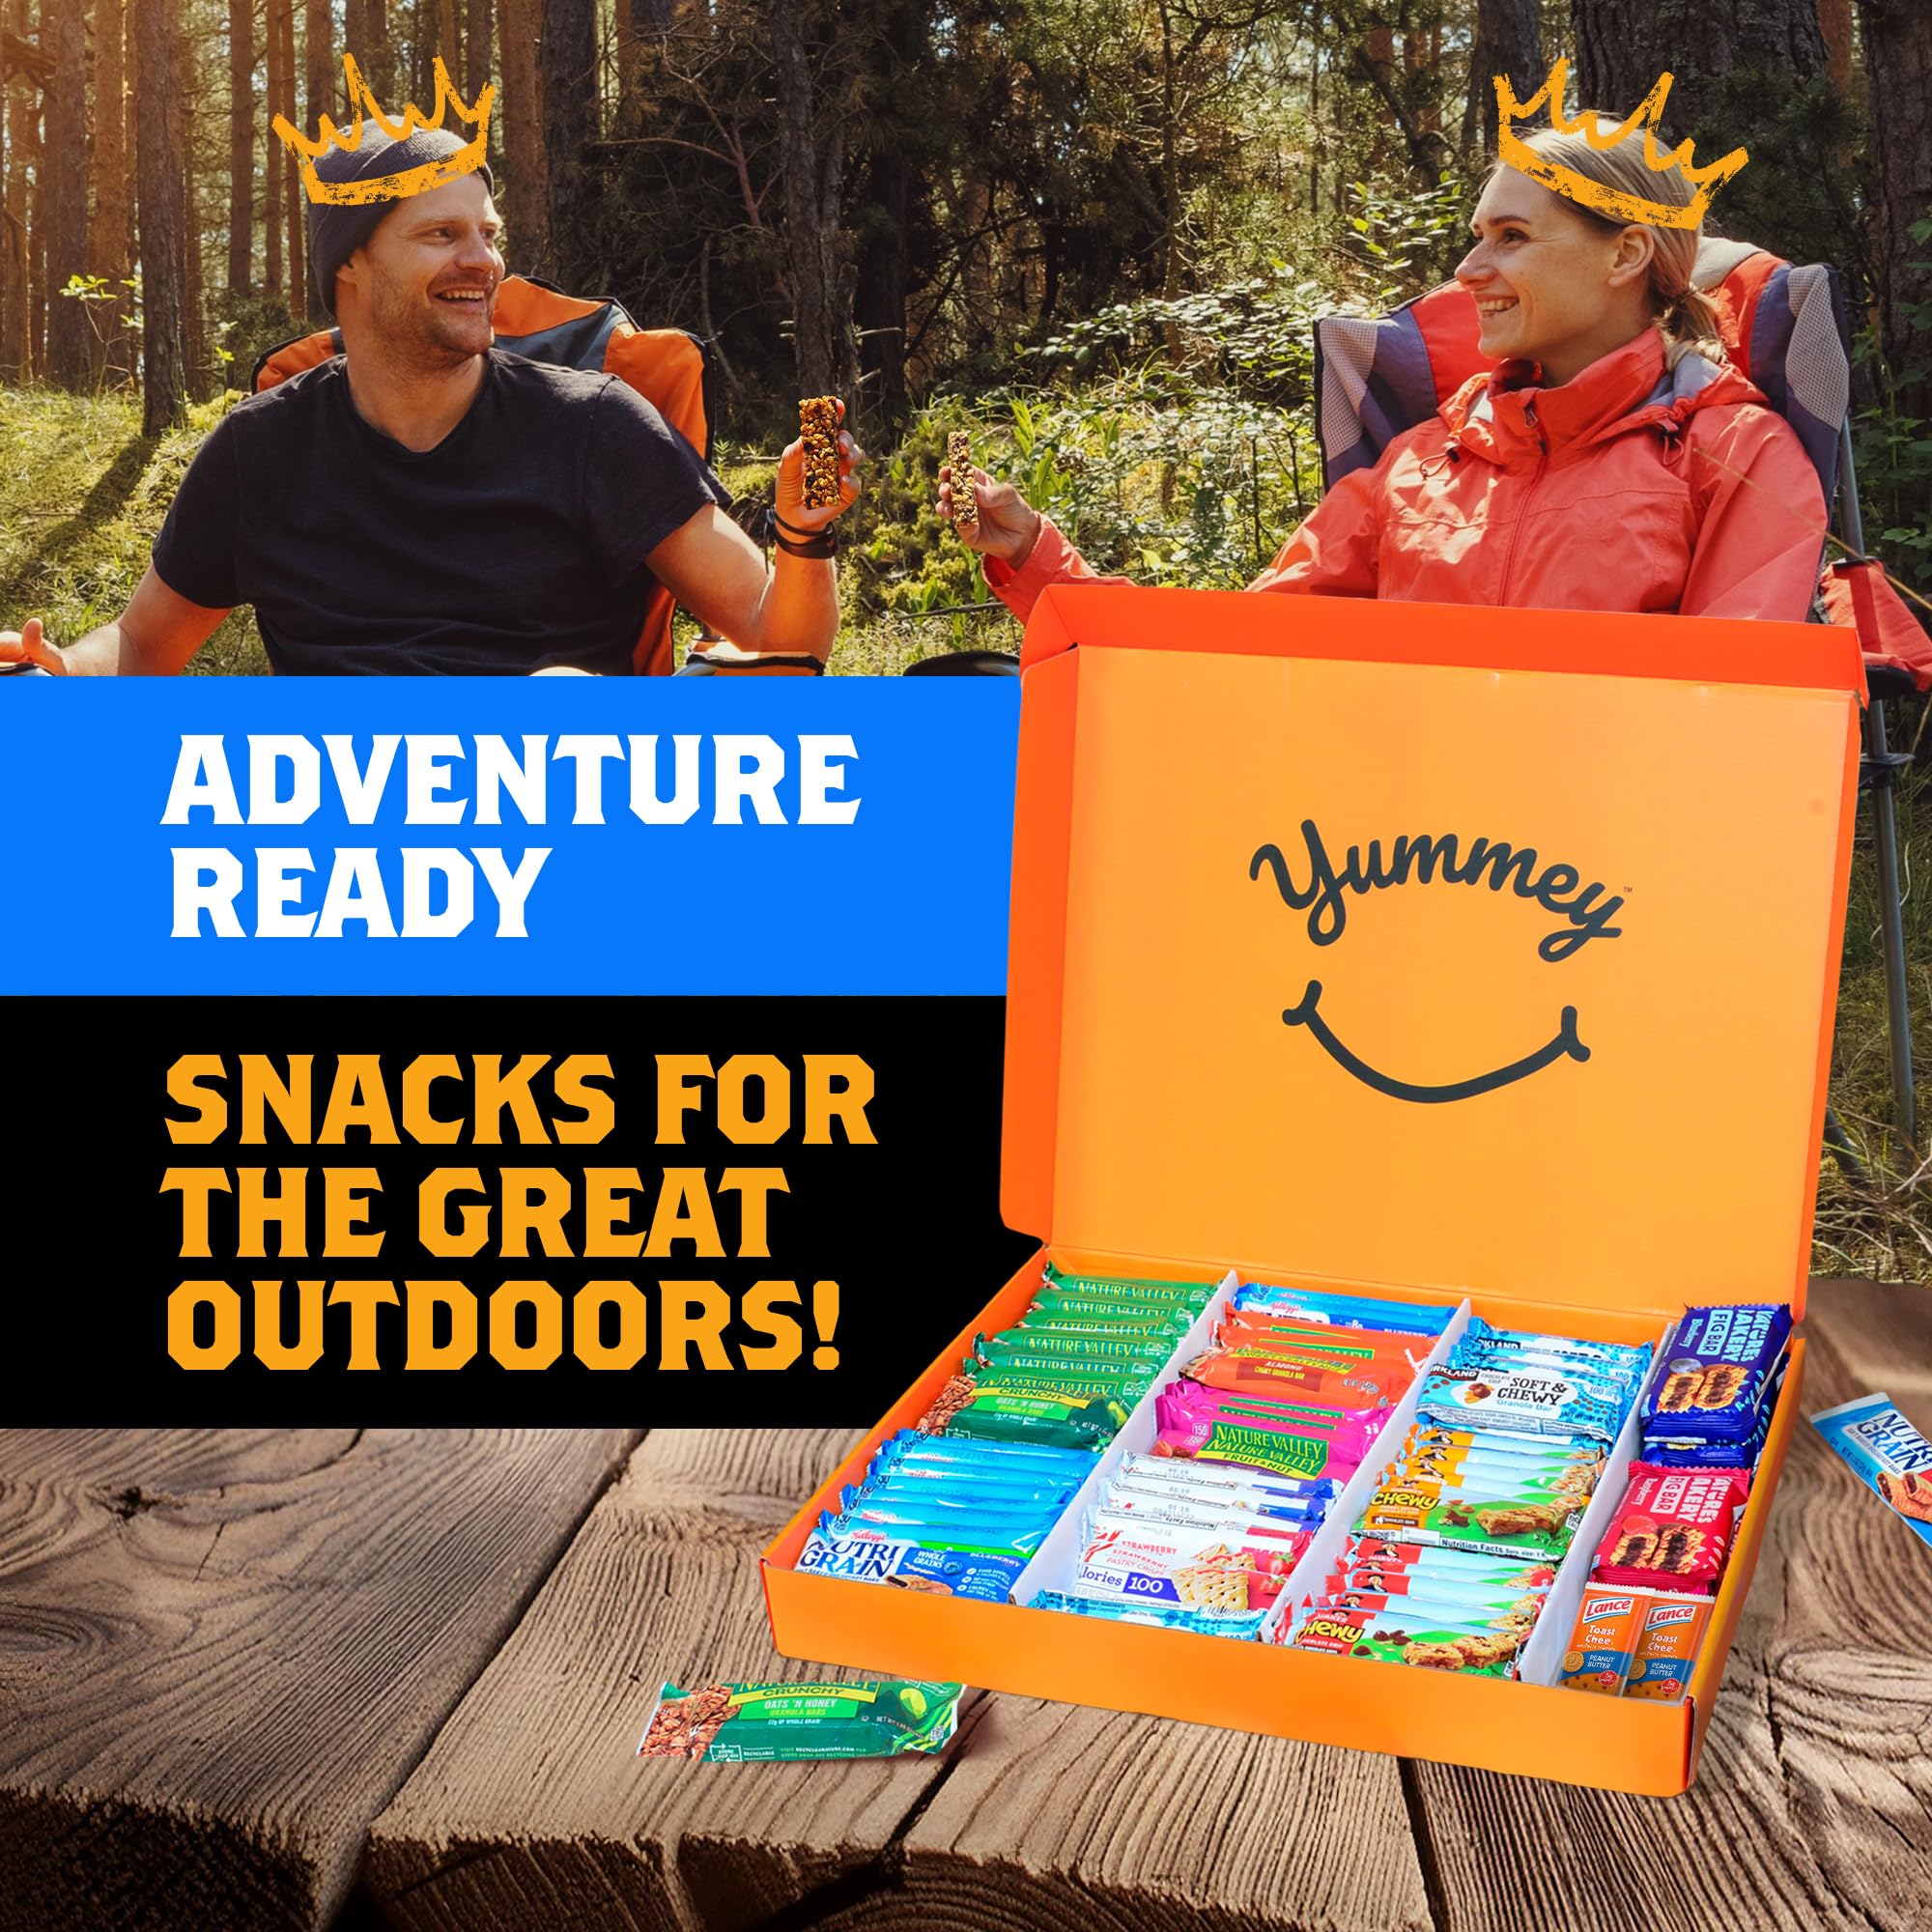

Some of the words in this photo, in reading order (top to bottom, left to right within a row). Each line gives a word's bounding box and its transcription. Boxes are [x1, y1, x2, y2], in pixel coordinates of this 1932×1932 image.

[1249, 819, 1624, 962] Yummey
[1078, 1281, 1128, 1297] NATURE
[1711, 1314, 1728, 1334] FIG
[1702, 1334, 1722, 1352] BAR
[1720, 1309, 1755, 1362] AKERY
[1029, 1337, 1082, 1353] NATURE
[1084, 1341, 1135, 1357] VALLEY
[1509, 1377, 1551, 1391] SOFT
[1551, 1382, 1569, 1393] &
[1588, 1386, 1605, 1396] 100
[999, 1386, 1066, 1401] CRUNCHY
[1497, 1387, 1563, 1406] CHEWY
[1495, 1398, 1533, 1409] Granola
[1535, 1403, 1552, 1412] Bar
[1194, 1424, 1208, 1435] 150
[1215, 1424, 1270, 1447] NATURE
[1272, 1435, 1323, 1460] VALLEY
[1857, 1422, 1928, 1470] GRAIN
[1207, 1438, 1268, 1457] NATURE
[1269, 1451, 1321, 1474] VALLEY
[1656, 1492, 1678, 1511] BAR
[851, 1529, 886, 1542] Kellogg's
[1441, 1539, 1478, 1551] Nutrition
[1480, 1543, 1504, 1554] Facts
[800, 1549, 894, 1577] GRAIN
[913, 1557, 943, 1569] GRAINS
[918, 1550, 947, 1561] WHOLE
[969, 1552, 1021, 1568] BLUEBERRY
[1106, 1557, 1137, 1569] PASTRY
[1112, 1548, 1168, 1569] STRAWBERRY
[1128, 1577, 1163, 1594] 100
[1585, 1600, 1632, 1618] Lance
[1648, 1607, 1693, 1625] Lance
[1589, 1625, 1616, 1635] Toast
[1651, 1632, 1678, 1643] Toast
[1585, 1634, 1611, 1645] Chee
[1647, 1642, 1673, 1653] Chee
[1587, 1661, 1611, 1669] BUTTER
[1589, 1654, 1615, 1662] PEANUT
[1649, 1668, 1673, 1677] BUTTER
[1651, 1662, 1677, 1670] PEANUT
[762, 1686, 846, 1697] CRUNCHY
[764, 1699, 788, 1709] OATS
[805, 1698, 838, 1708] HONEY
